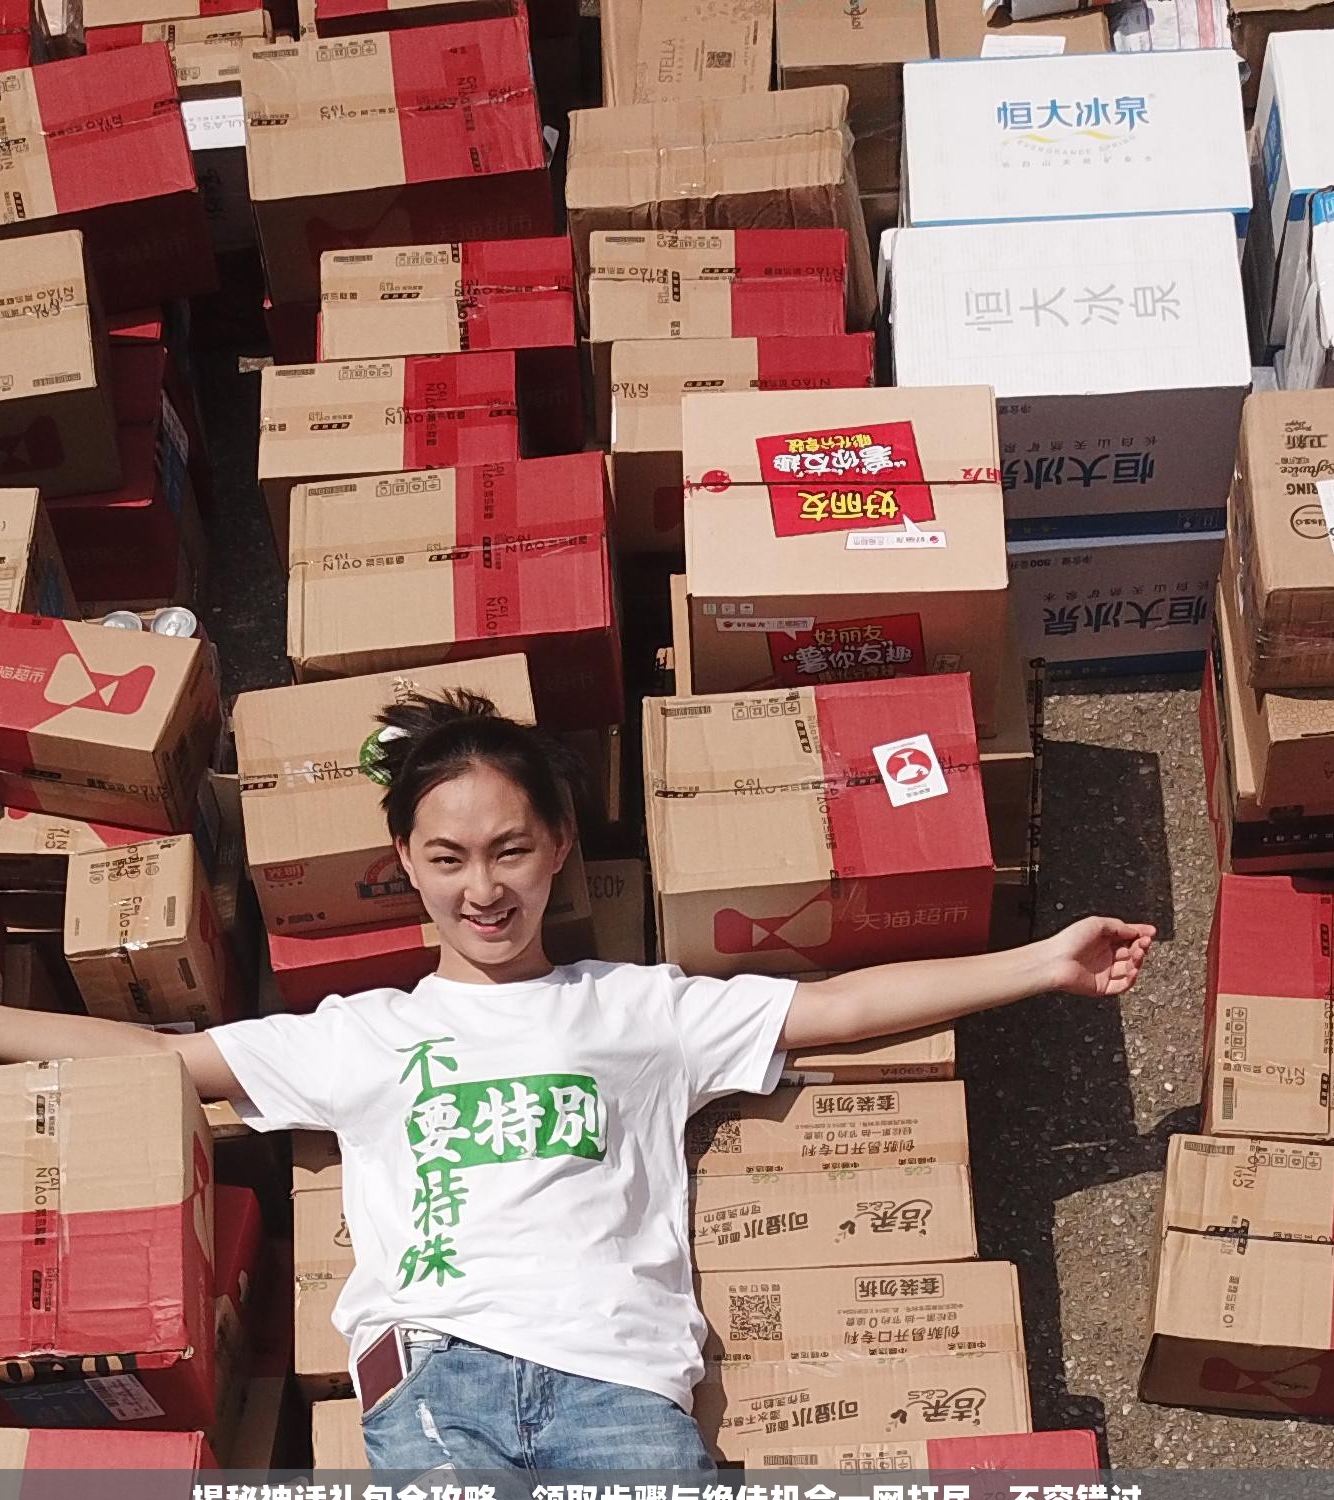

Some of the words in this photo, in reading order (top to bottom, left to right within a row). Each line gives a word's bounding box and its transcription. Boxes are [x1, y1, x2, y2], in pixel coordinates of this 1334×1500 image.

[658, 38, 675, 83] STELLA
[996, 95, 1151, 131] 恒大冰泉
[965, 281, 1181, 331] 恒大冰泉
[797, 489, 900, 521] 好丽友
[1042, 596, 1210, 637] 恒大冰泉
[814, 625, 884, 646] 好丽友
[853, 904, 970, 934] 天猫超市
[816, 1094, 898, 1114] 套装勿拆
[801, 1139, 916, 1158] 创新易开口专利
[857, 1200, 897, 1212] C&S
[870, 1206, 933, 1238] 洁柔
[858, 1277, 941, 1298] 套装勿拆
[843, 1324, 961, 1346] 创新易开口专利
[920, 1396, 988, 1428] 洁柔
